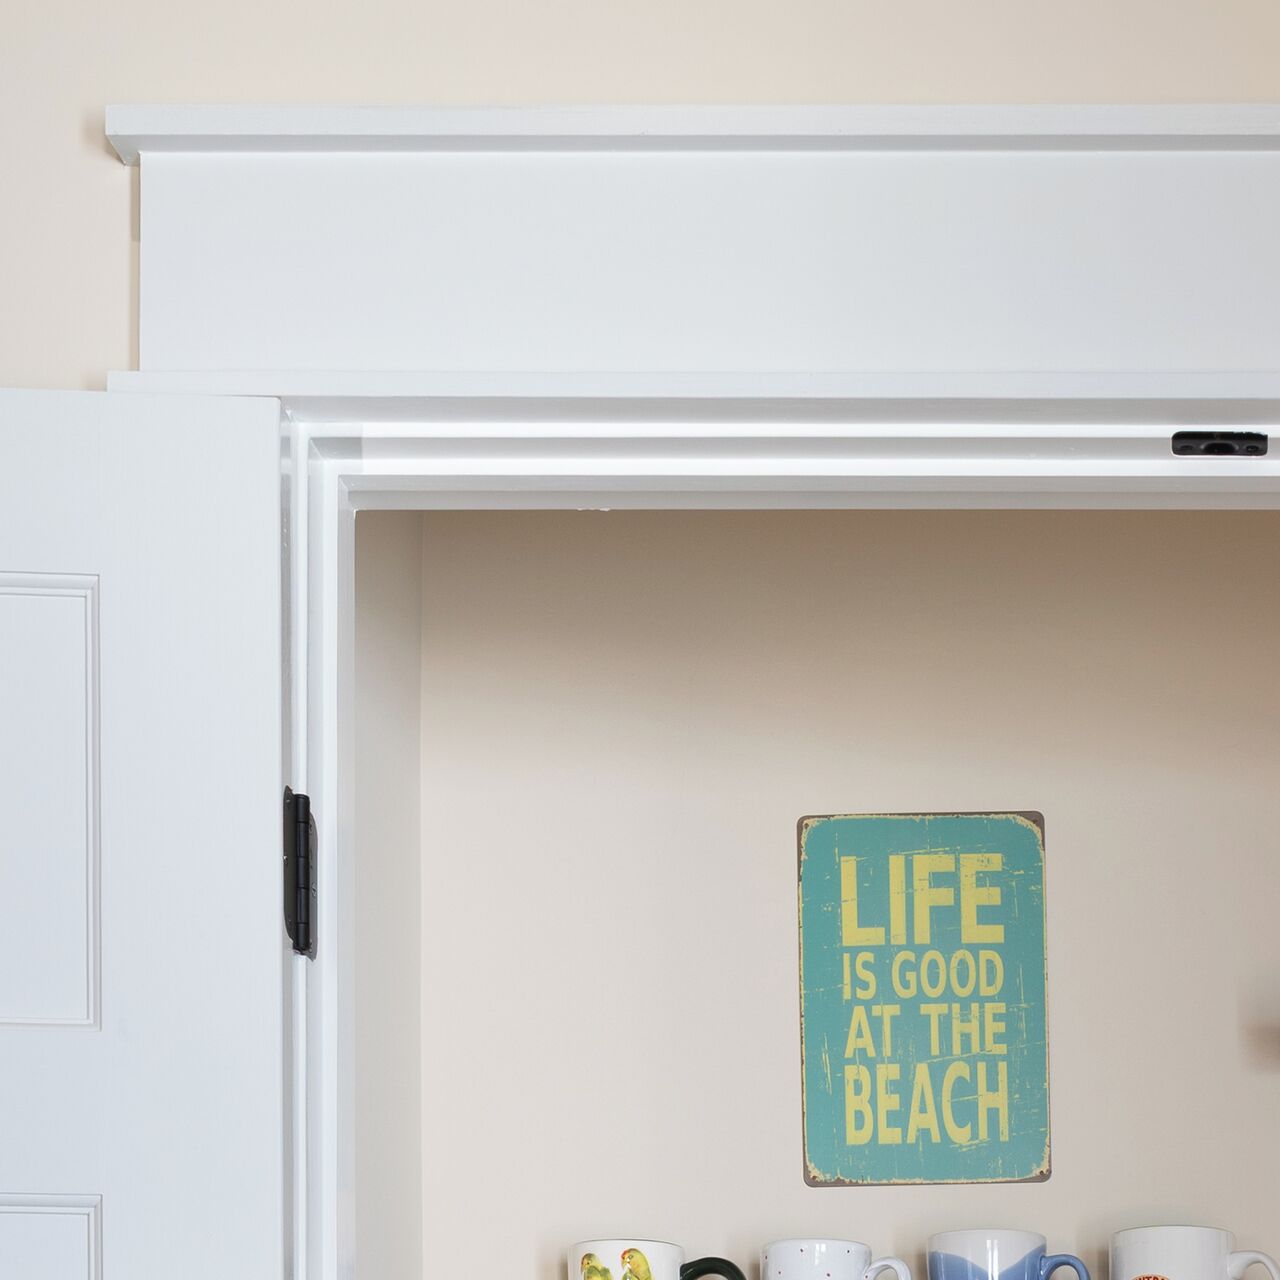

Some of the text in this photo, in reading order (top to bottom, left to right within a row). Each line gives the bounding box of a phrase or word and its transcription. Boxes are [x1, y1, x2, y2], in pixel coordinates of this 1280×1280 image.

[840, 853, 1005, 947] LIFE
[841, 949, 1004, 1001] IS GOOD
[844, 1002, 1008, 1059] AT THE
[844, 1061, 1010, 1146] BEACH
